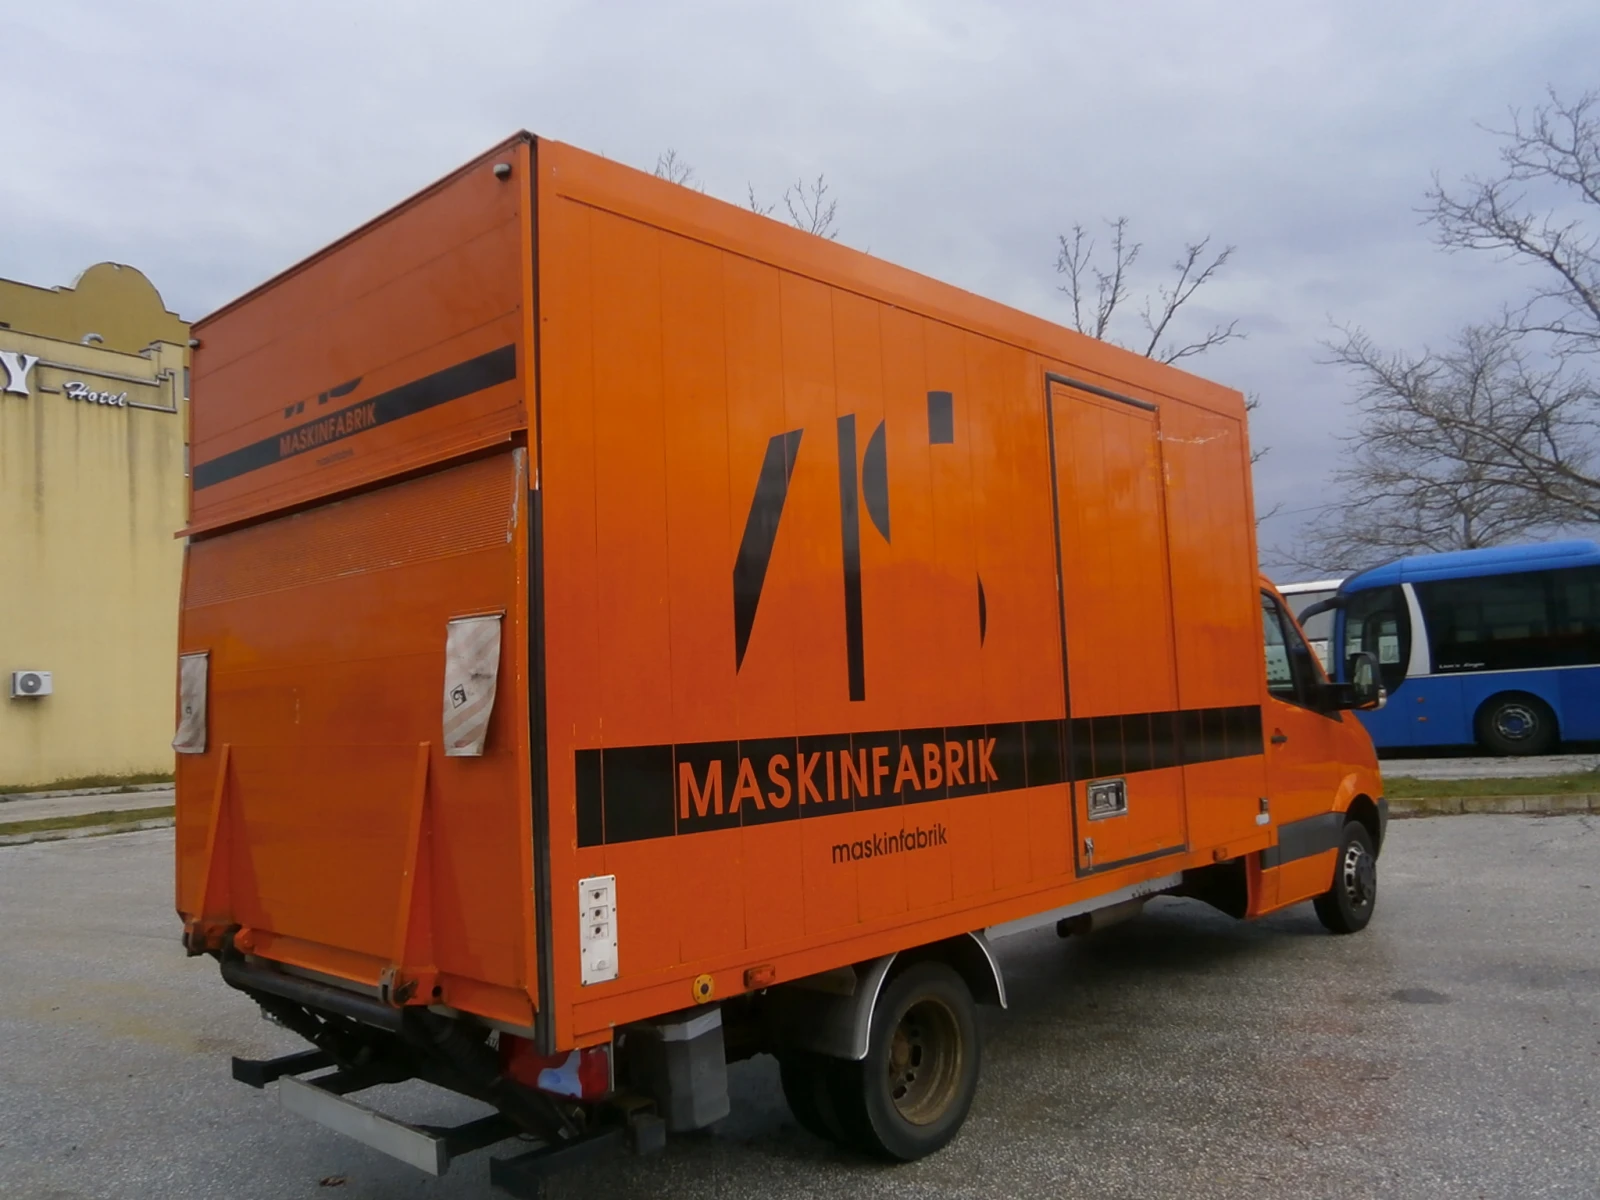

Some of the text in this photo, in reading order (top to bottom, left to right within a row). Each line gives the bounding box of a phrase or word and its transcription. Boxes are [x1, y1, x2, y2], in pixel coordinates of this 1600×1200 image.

[63, 381, 127, 406] Hotel
[280, 402, 376, 457] MASKINFABRIK
[678, 738, 999, 819] MASKINFABRIK
[832, 823, 947, 864] maskinfabrik
